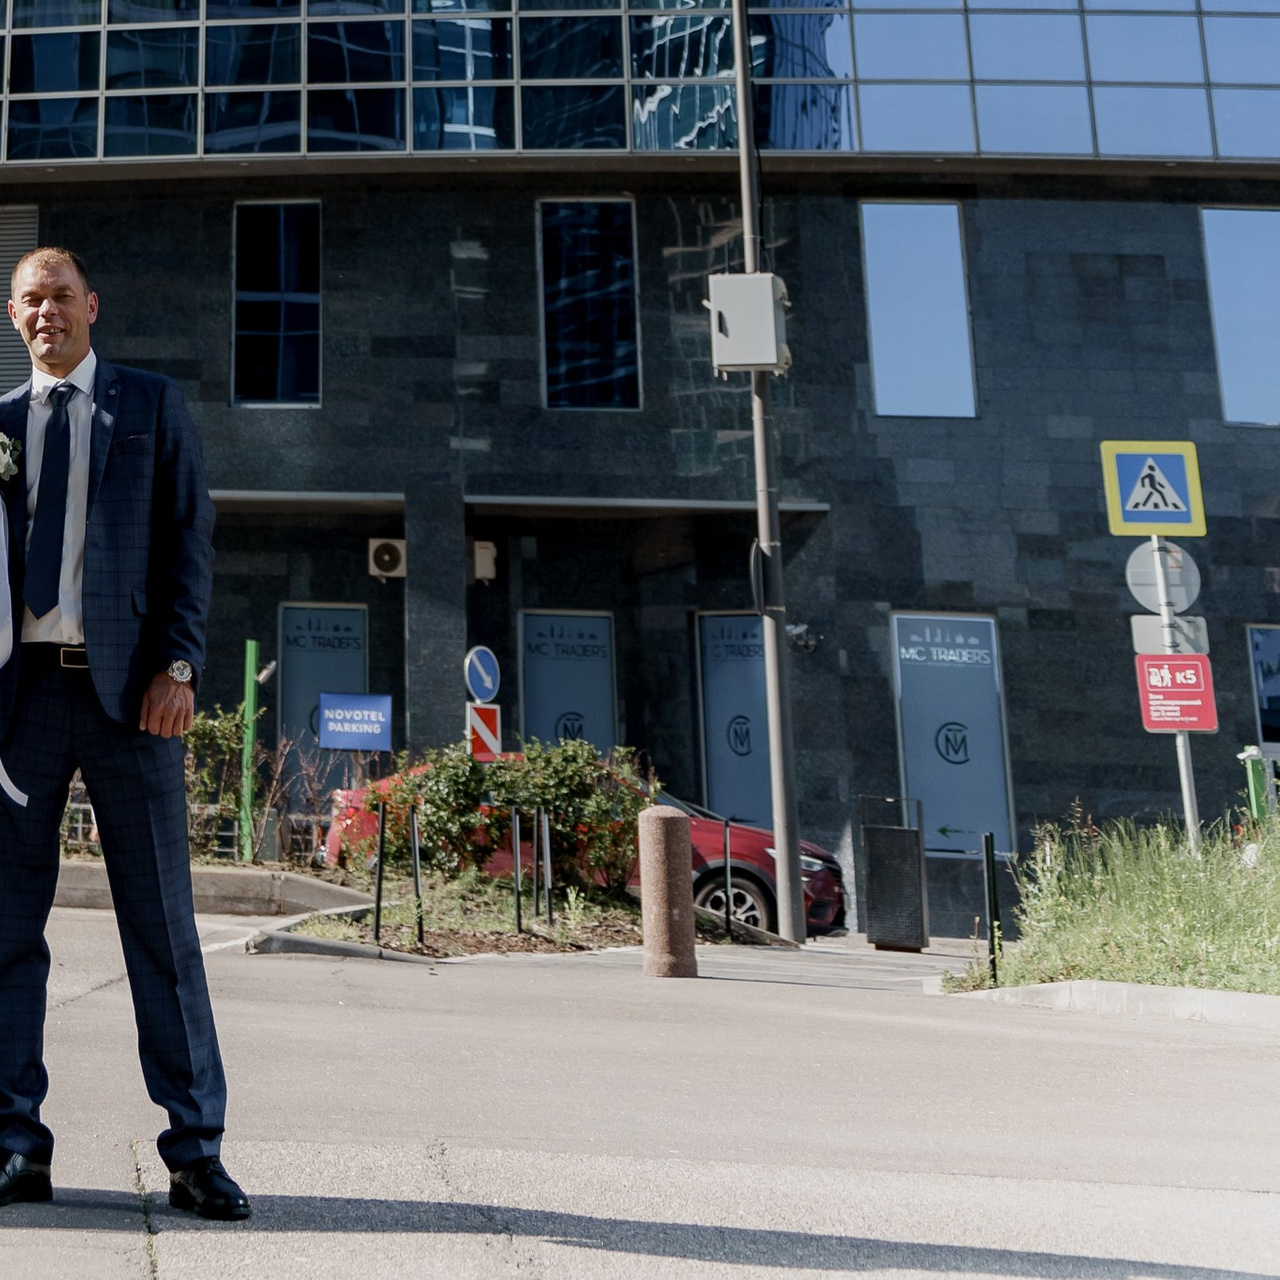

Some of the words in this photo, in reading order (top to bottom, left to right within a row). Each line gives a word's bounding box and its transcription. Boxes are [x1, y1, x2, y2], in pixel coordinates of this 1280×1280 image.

[900, 647, 926, 661] MC
[930, 647, 991, 664] TRADERS
[323, 709, 386, 722] NOVOTEL
[327, 721, 382, 734] PARKING
